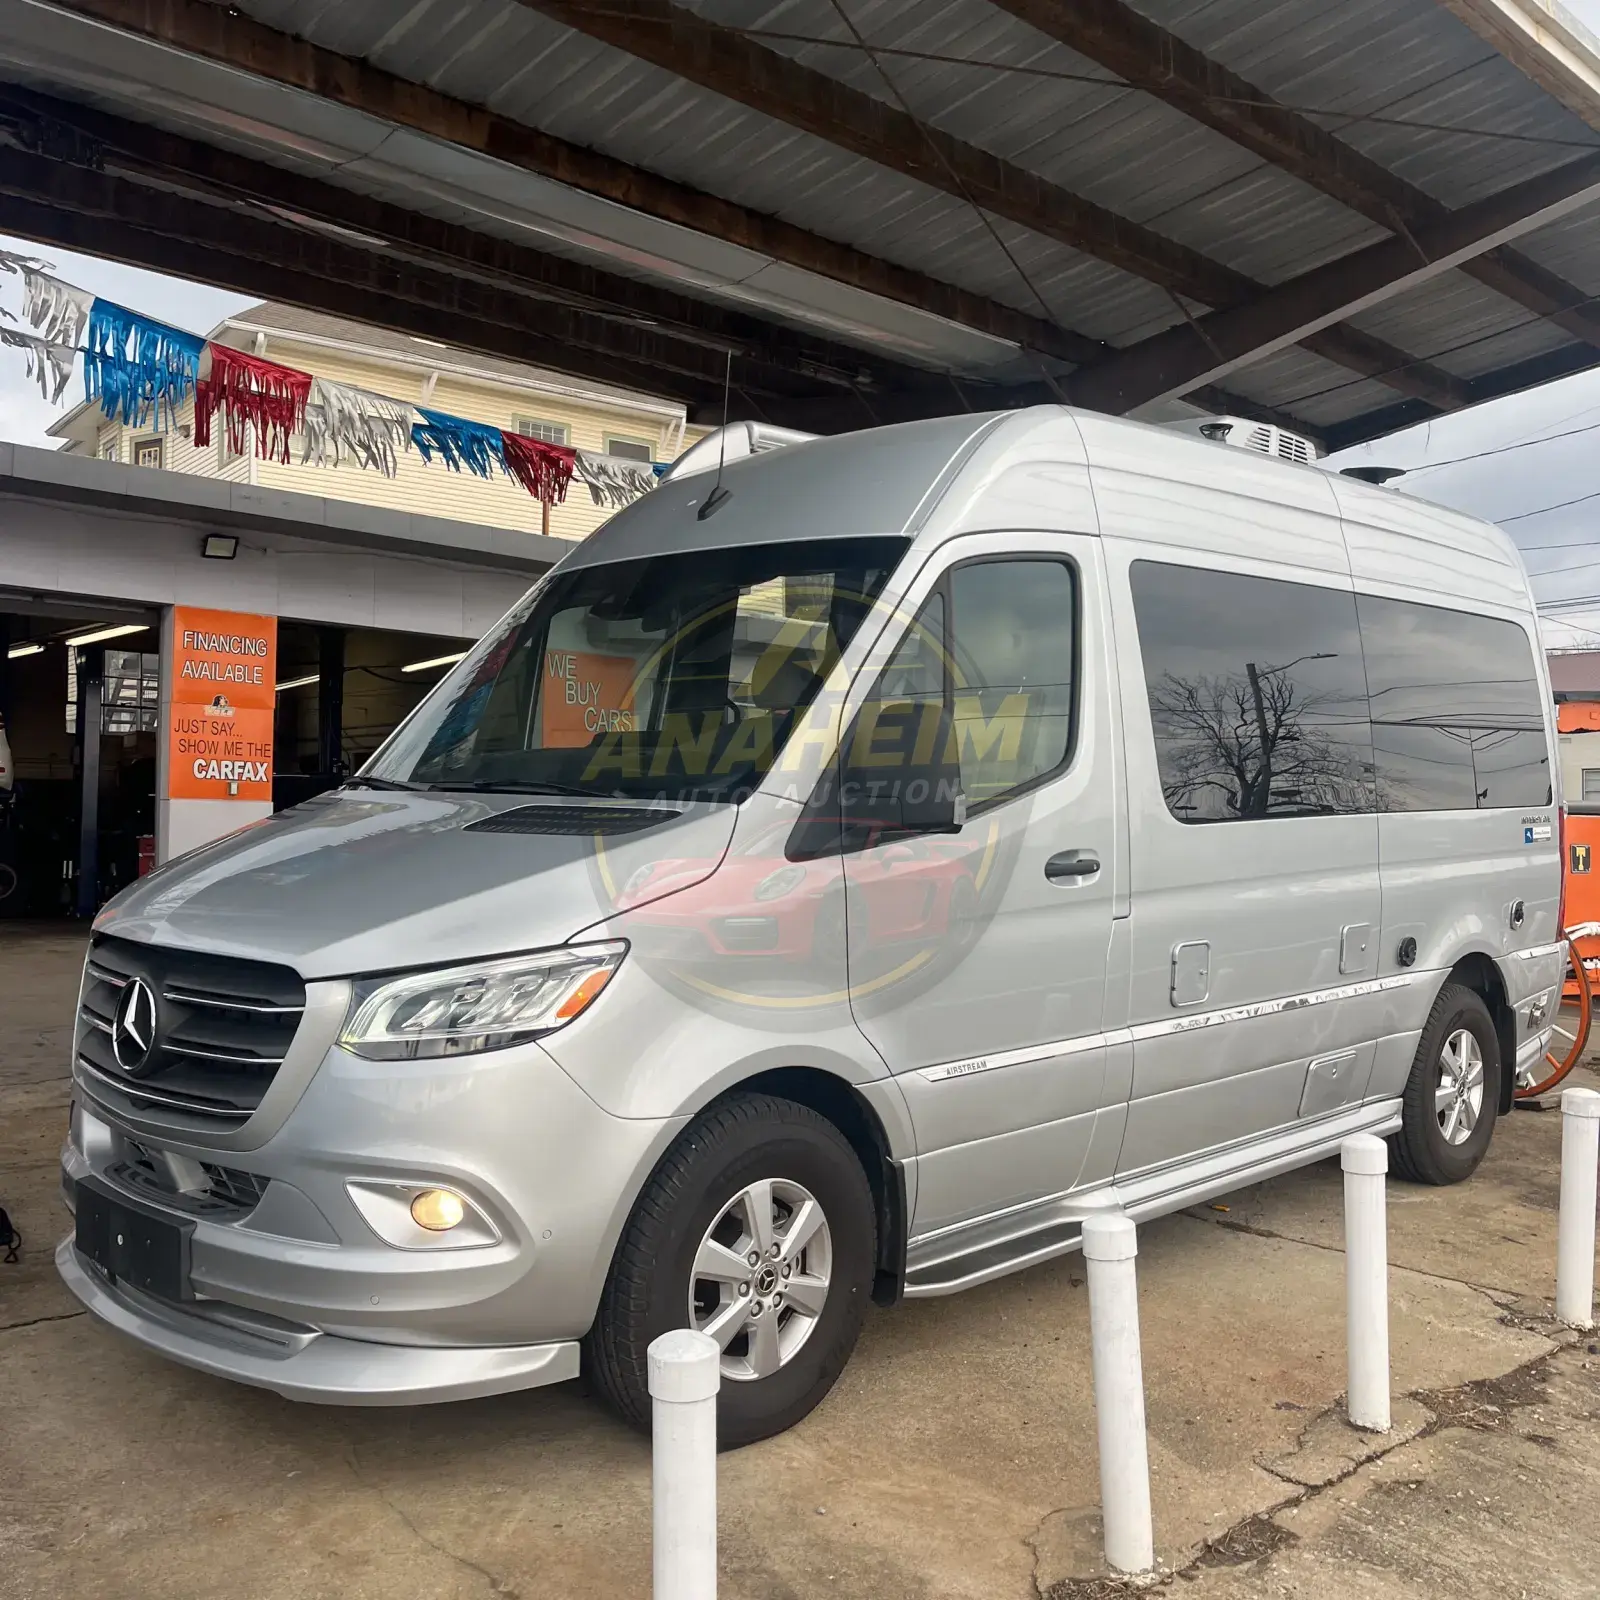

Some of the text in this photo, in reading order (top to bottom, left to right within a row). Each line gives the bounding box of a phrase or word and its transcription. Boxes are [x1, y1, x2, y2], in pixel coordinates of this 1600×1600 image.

[183, 630, 267, 657] FINANCING
[181, 660, 263, 684] AVAILABLE
[548, 653, 577, 679] WE
[565, 681, 601, 705] BUY
[174, 718, 243, 738] JUST SAY...
[584, 707, 632, 732] CARS
[178, 738, 271, 758] SHOW ME THE
[193, 758, 269, 782] CARFAX
[946, 1060, 987, 1076] AIRSTREAM
